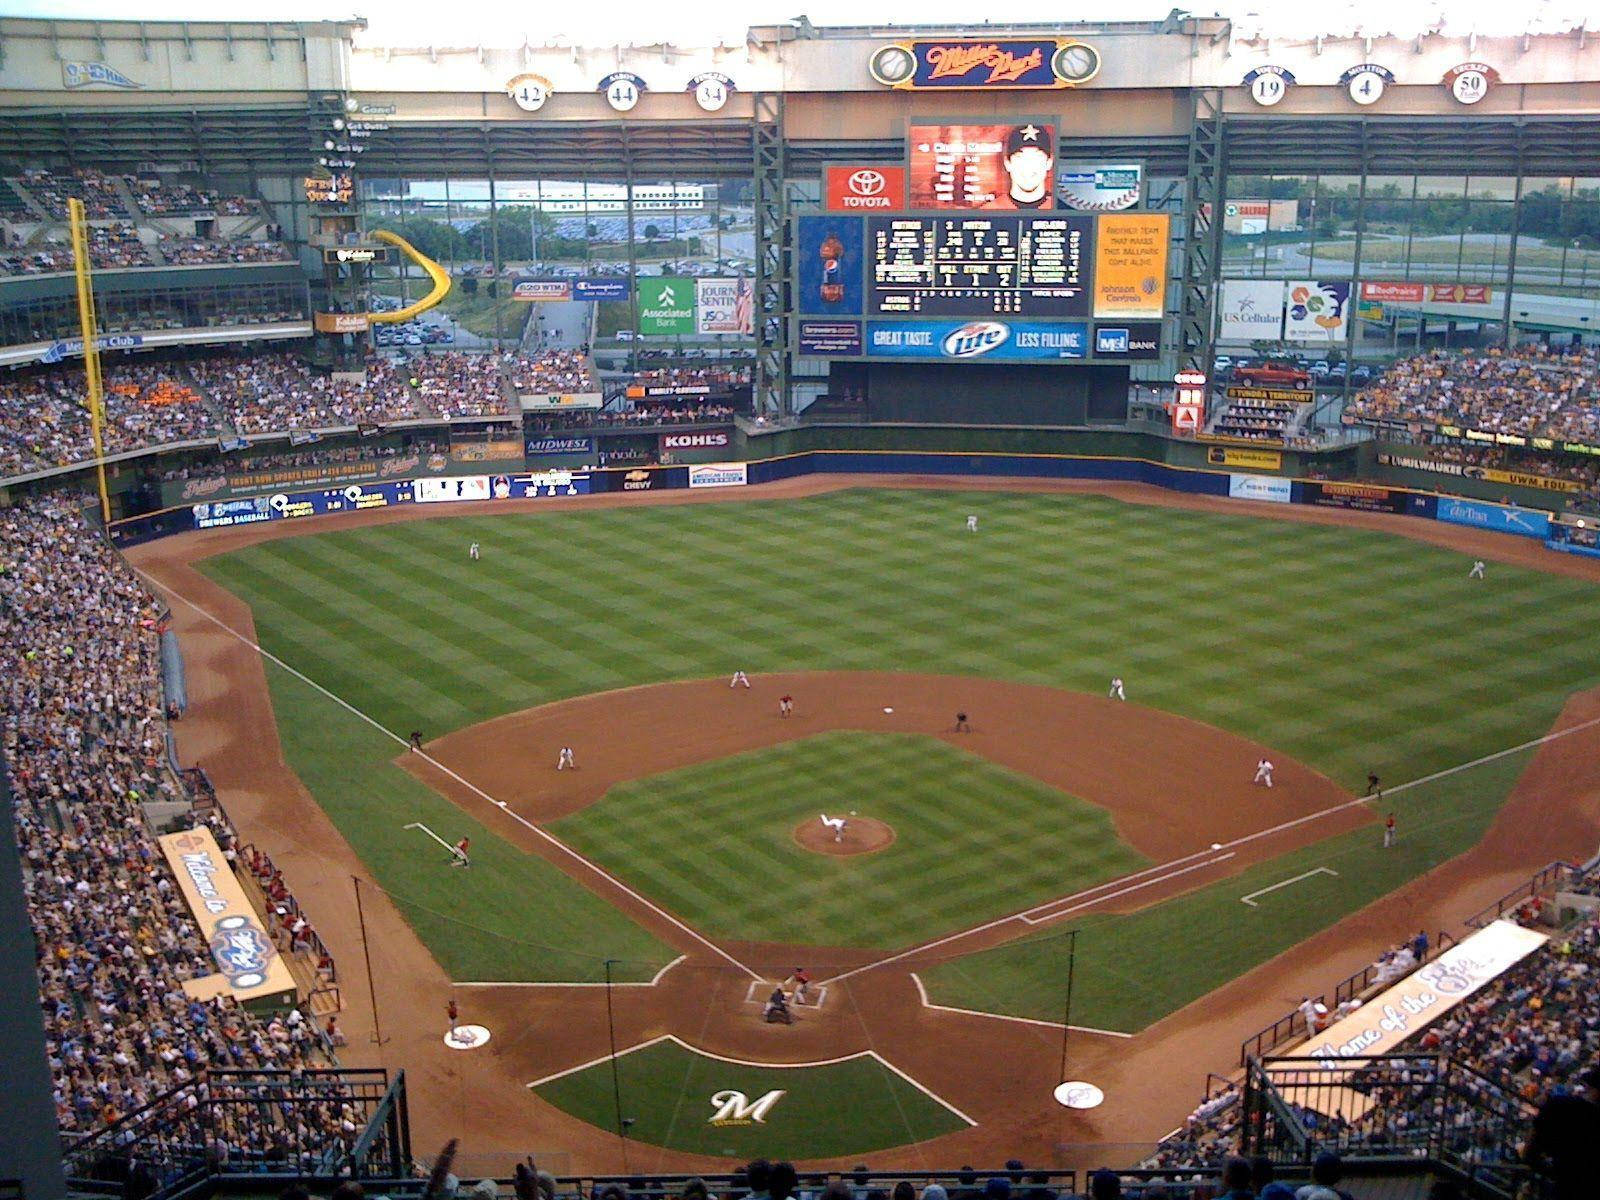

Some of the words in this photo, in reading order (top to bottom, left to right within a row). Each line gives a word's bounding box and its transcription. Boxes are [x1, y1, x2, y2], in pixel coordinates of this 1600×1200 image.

[926, 45, 998, 79] Miller
[984, 48, 1042, 83] Park
[1260, 81, 1279, 97] 19
[1359, 80, 1371, 95] 4
[520, 87, 540, 102] 42
[612, 87, 633, 102] 44
[842, 196, 891, 207] TOYOTA
[1000, 274, 1010, 287] 2
[702, 287, 737, 297] JOURN
[700, 297, 737, 306] SENTIN
[642, 308, 692, 318] Associated
[1241, 312, 1280, 324] Cellular
[656, 319, 677, 328] Bank
[109, 336, 134, 346] Club
[873, 331, 902, 346] GREAT
[953, 329, 1001, 355] Lite
[1016, 333, 1039, 347] LESS
[1129, 341, 1156, 350] BANK
[1269, 391, 1312, 401] TERRITORY
[528, 439, 587, 450] MIDWEST
[665, 434, 728, 447] KOHL'S
[623, 481, 652, 490] CHEVY
[234, 512, 270, 524] BASEBALL
[1400, 991, 1439, 1015] the
